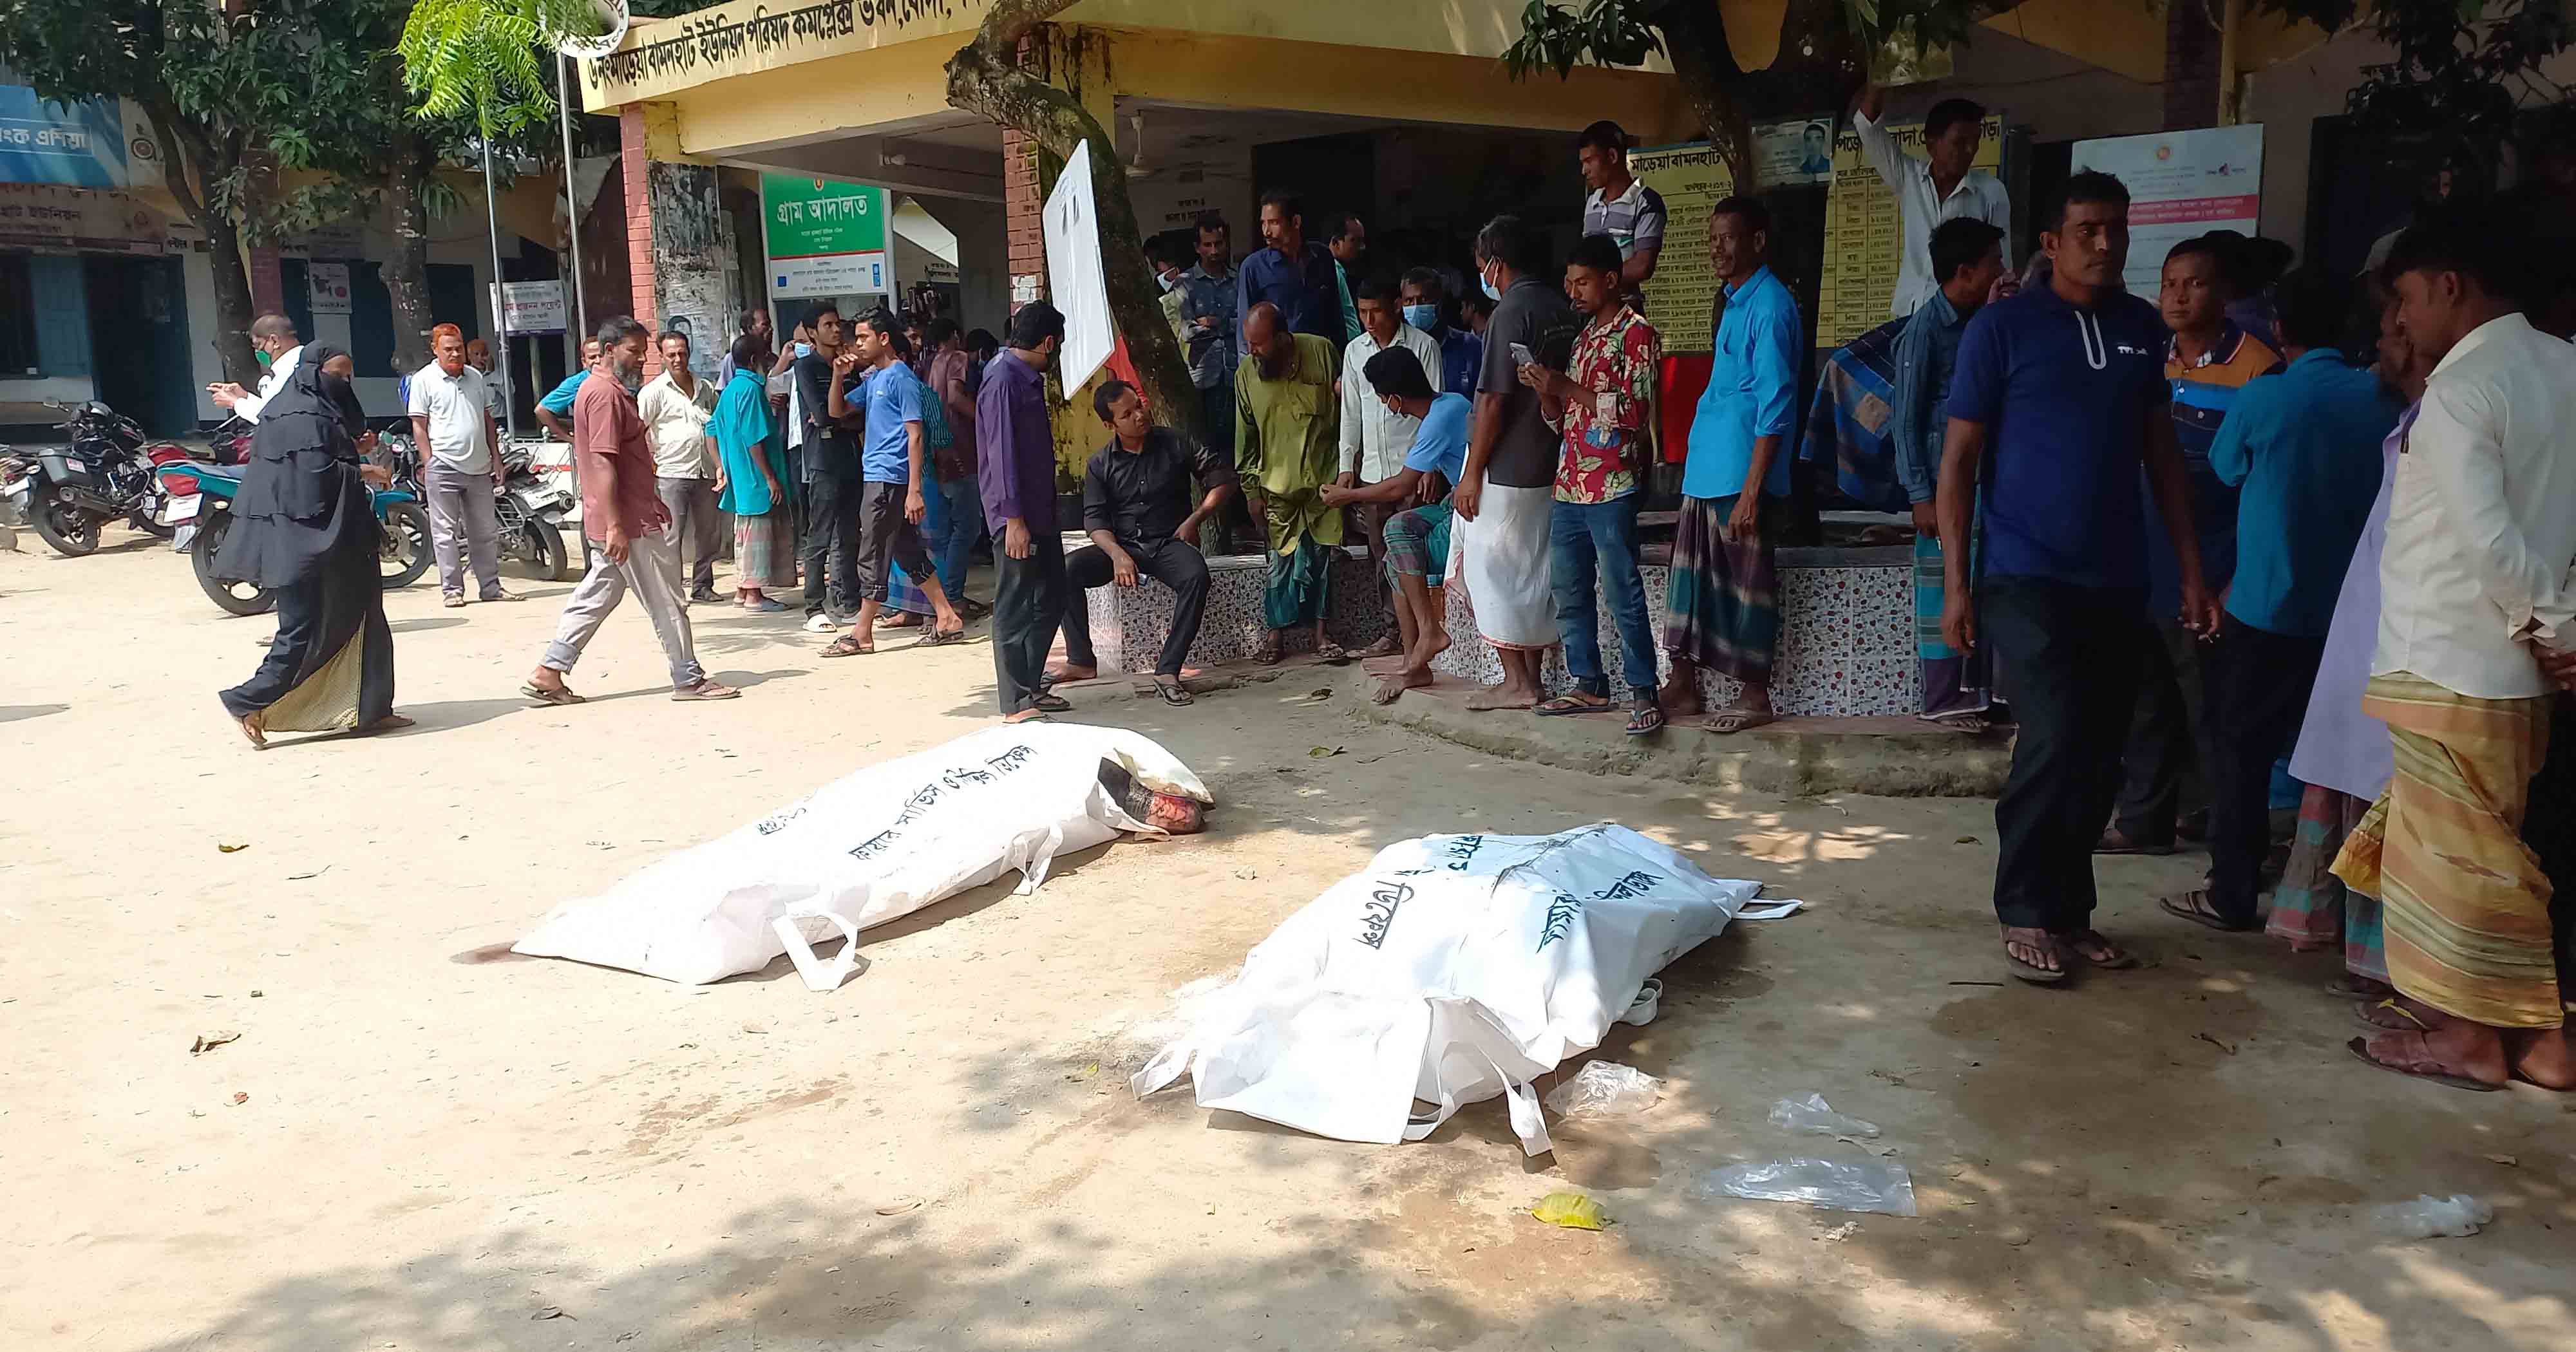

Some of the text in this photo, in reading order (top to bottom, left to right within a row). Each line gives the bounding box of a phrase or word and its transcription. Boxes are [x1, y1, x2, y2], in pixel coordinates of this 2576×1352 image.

[695, 13, 747, 70] ইউনিয়ন
[746, 5, 791, 53] পরিষদ
[1630, 146, 1721, 174] মাড়েয়া বামনহাট
[777, 195, 867, 226] গ্রাম আদালত
